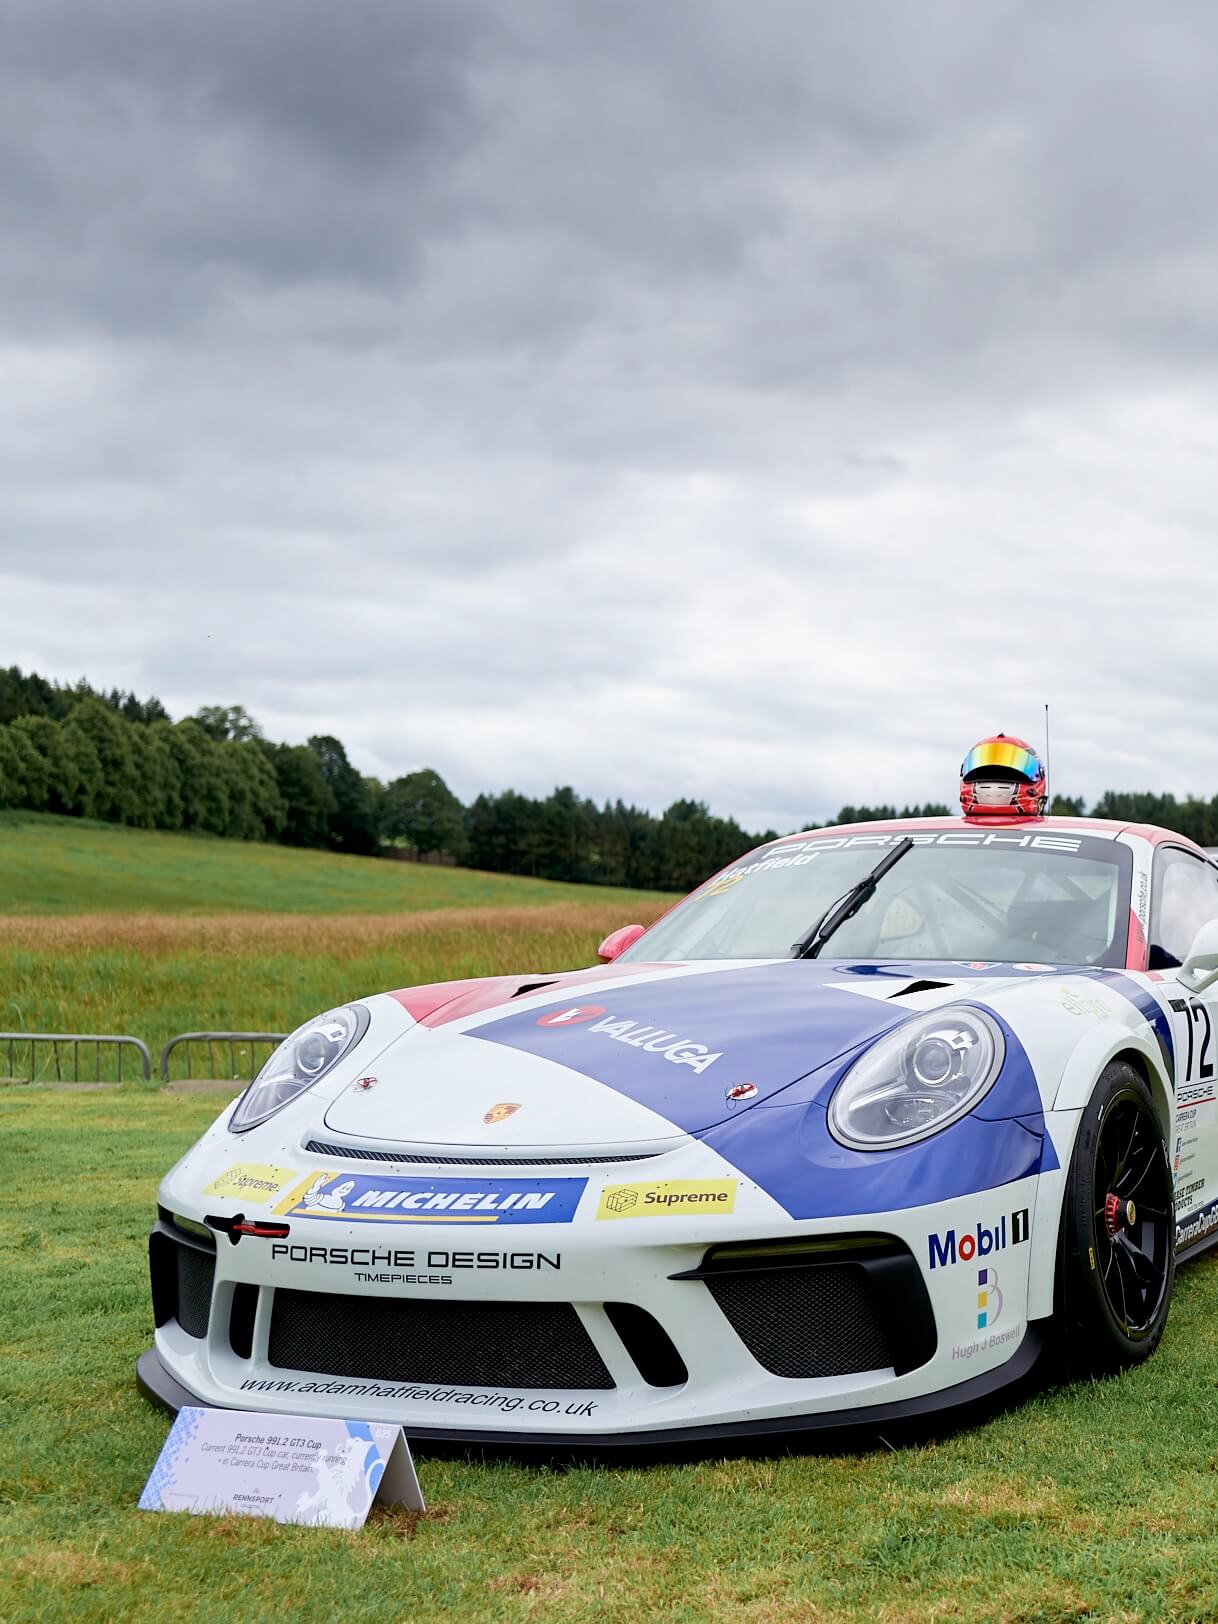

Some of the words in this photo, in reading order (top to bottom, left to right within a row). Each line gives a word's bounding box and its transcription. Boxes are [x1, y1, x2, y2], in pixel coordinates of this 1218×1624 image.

[760, 833, 1082, 859] PORSCHE
[587, 1015, 724, 1075] VALLUGA
[1168, 997, 1214, 1082] 72
[1177, 1085, 1214, 1103] PORSCHE
[232, 1174, 279, 1192] Supreme
[351, 1190, 556, 1210] MICHELIN
[643, 1190, 729, 1207] Supreme
[928, 1215, 1007, 1270] Mobil
[272, 1244, 415, 1267] PORSCHE
[427, 1251, 561, 1270] DESIGN
[355, 1273, 453, 1285] TIMEPIECES
[952, 1343, 979, 1361] Hugh
[989, 1327, 1021, 1348] Boswell
[240, 1376, 599, 1418] www.adamhatfieldracing.co.uk
[235, 1433, 265, 1445] Porsche
[267, 1436, 289, 1446] 991.2
[290, 1438, 306, 1447] GT3
[307, 1440, 322, 1450] Cup
[233, 1493, 275, 1504] RENNSPORT
